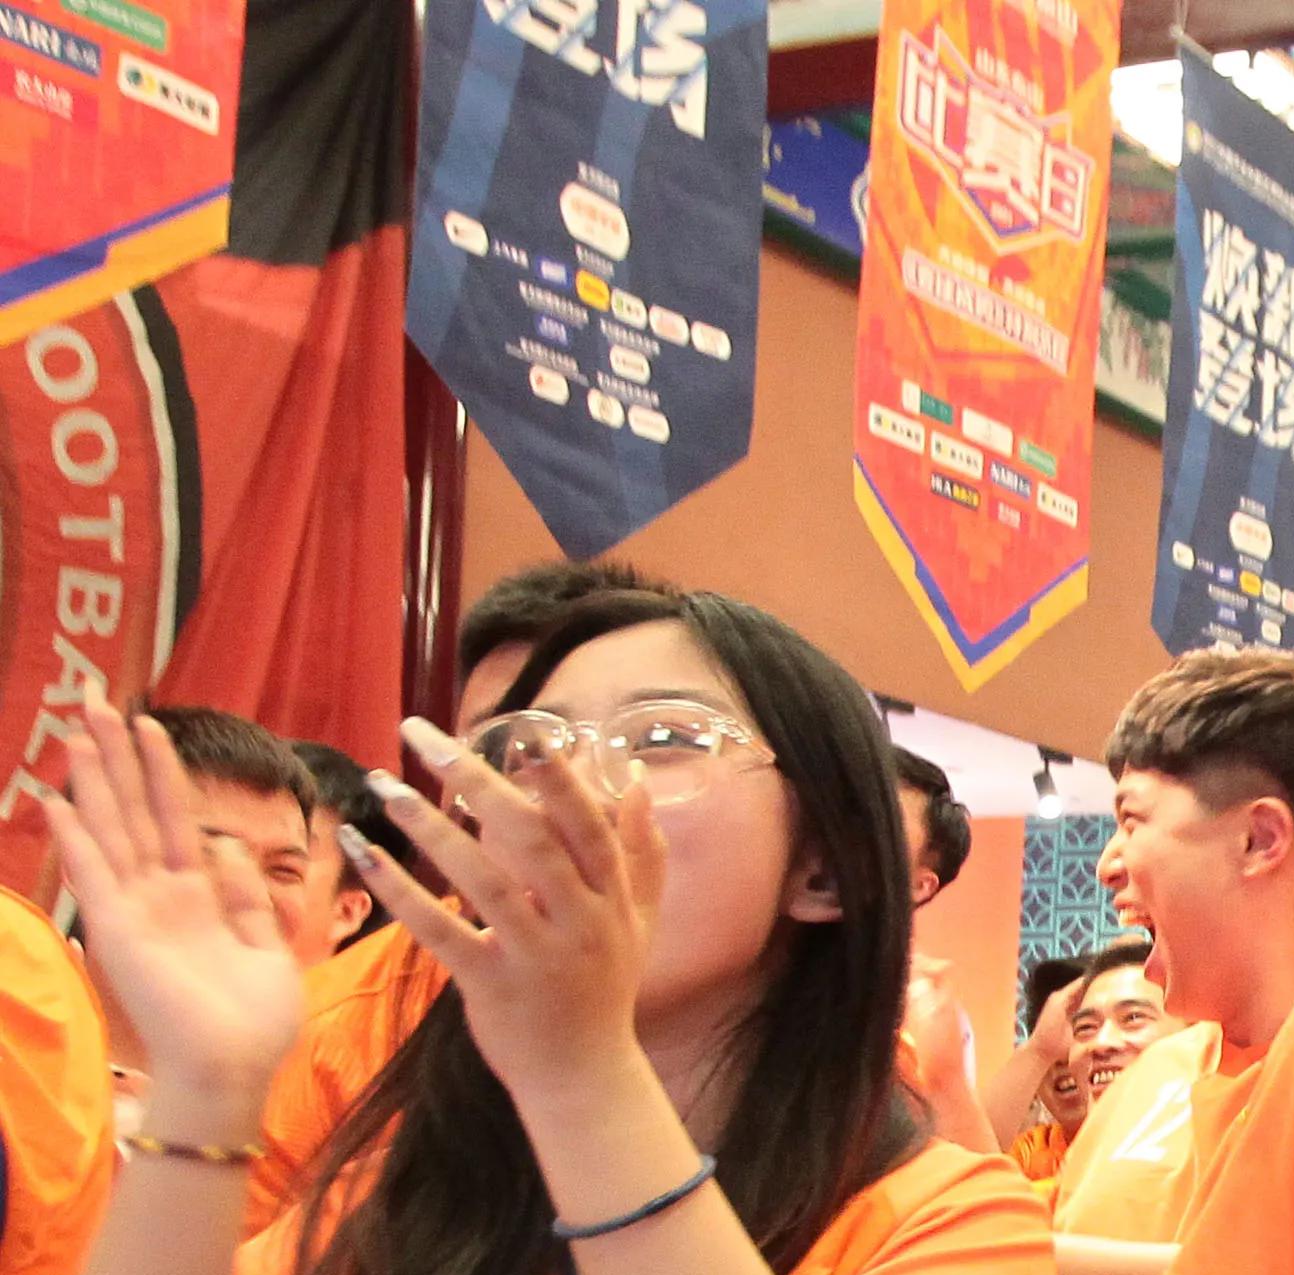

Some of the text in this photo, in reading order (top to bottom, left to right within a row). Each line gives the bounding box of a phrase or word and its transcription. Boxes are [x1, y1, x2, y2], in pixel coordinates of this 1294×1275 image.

[904, 46, 1087, 235] 比赛日
[0, 325, 124, 822] OOTBALL
